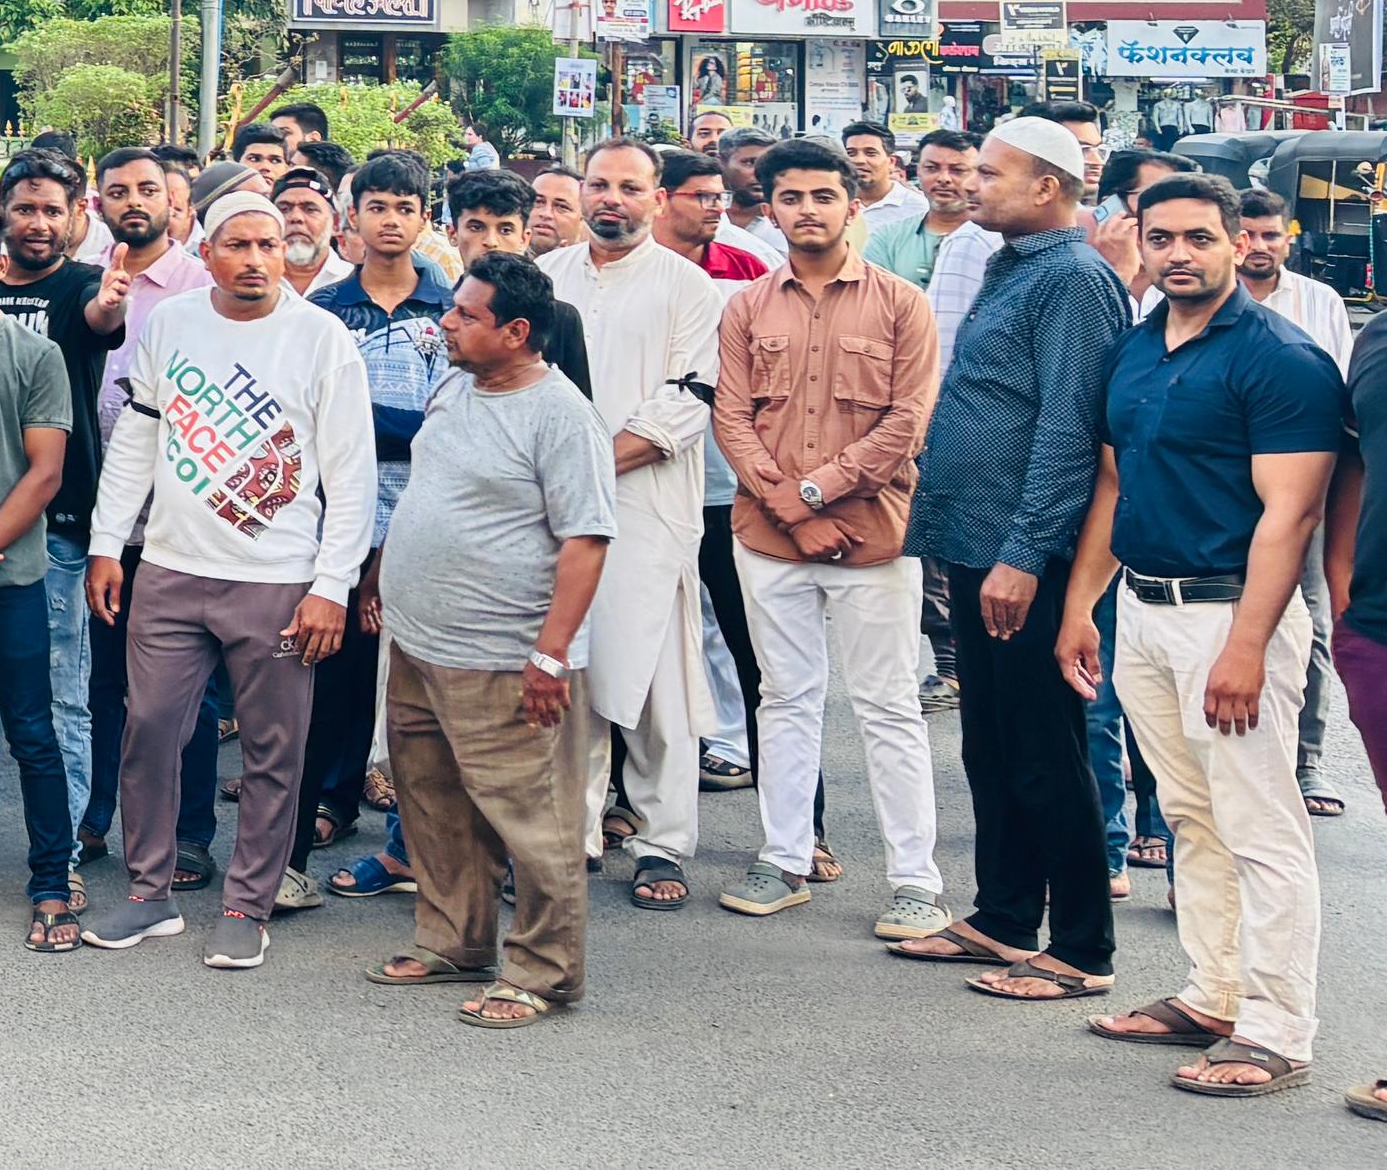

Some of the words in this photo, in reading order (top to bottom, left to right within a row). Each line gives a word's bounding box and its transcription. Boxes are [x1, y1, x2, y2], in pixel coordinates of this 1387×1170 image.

[165, 349, 261, 451] NORTH
[165, 394, 236, 474] FACE
[224, 362, 283, 430] THE
